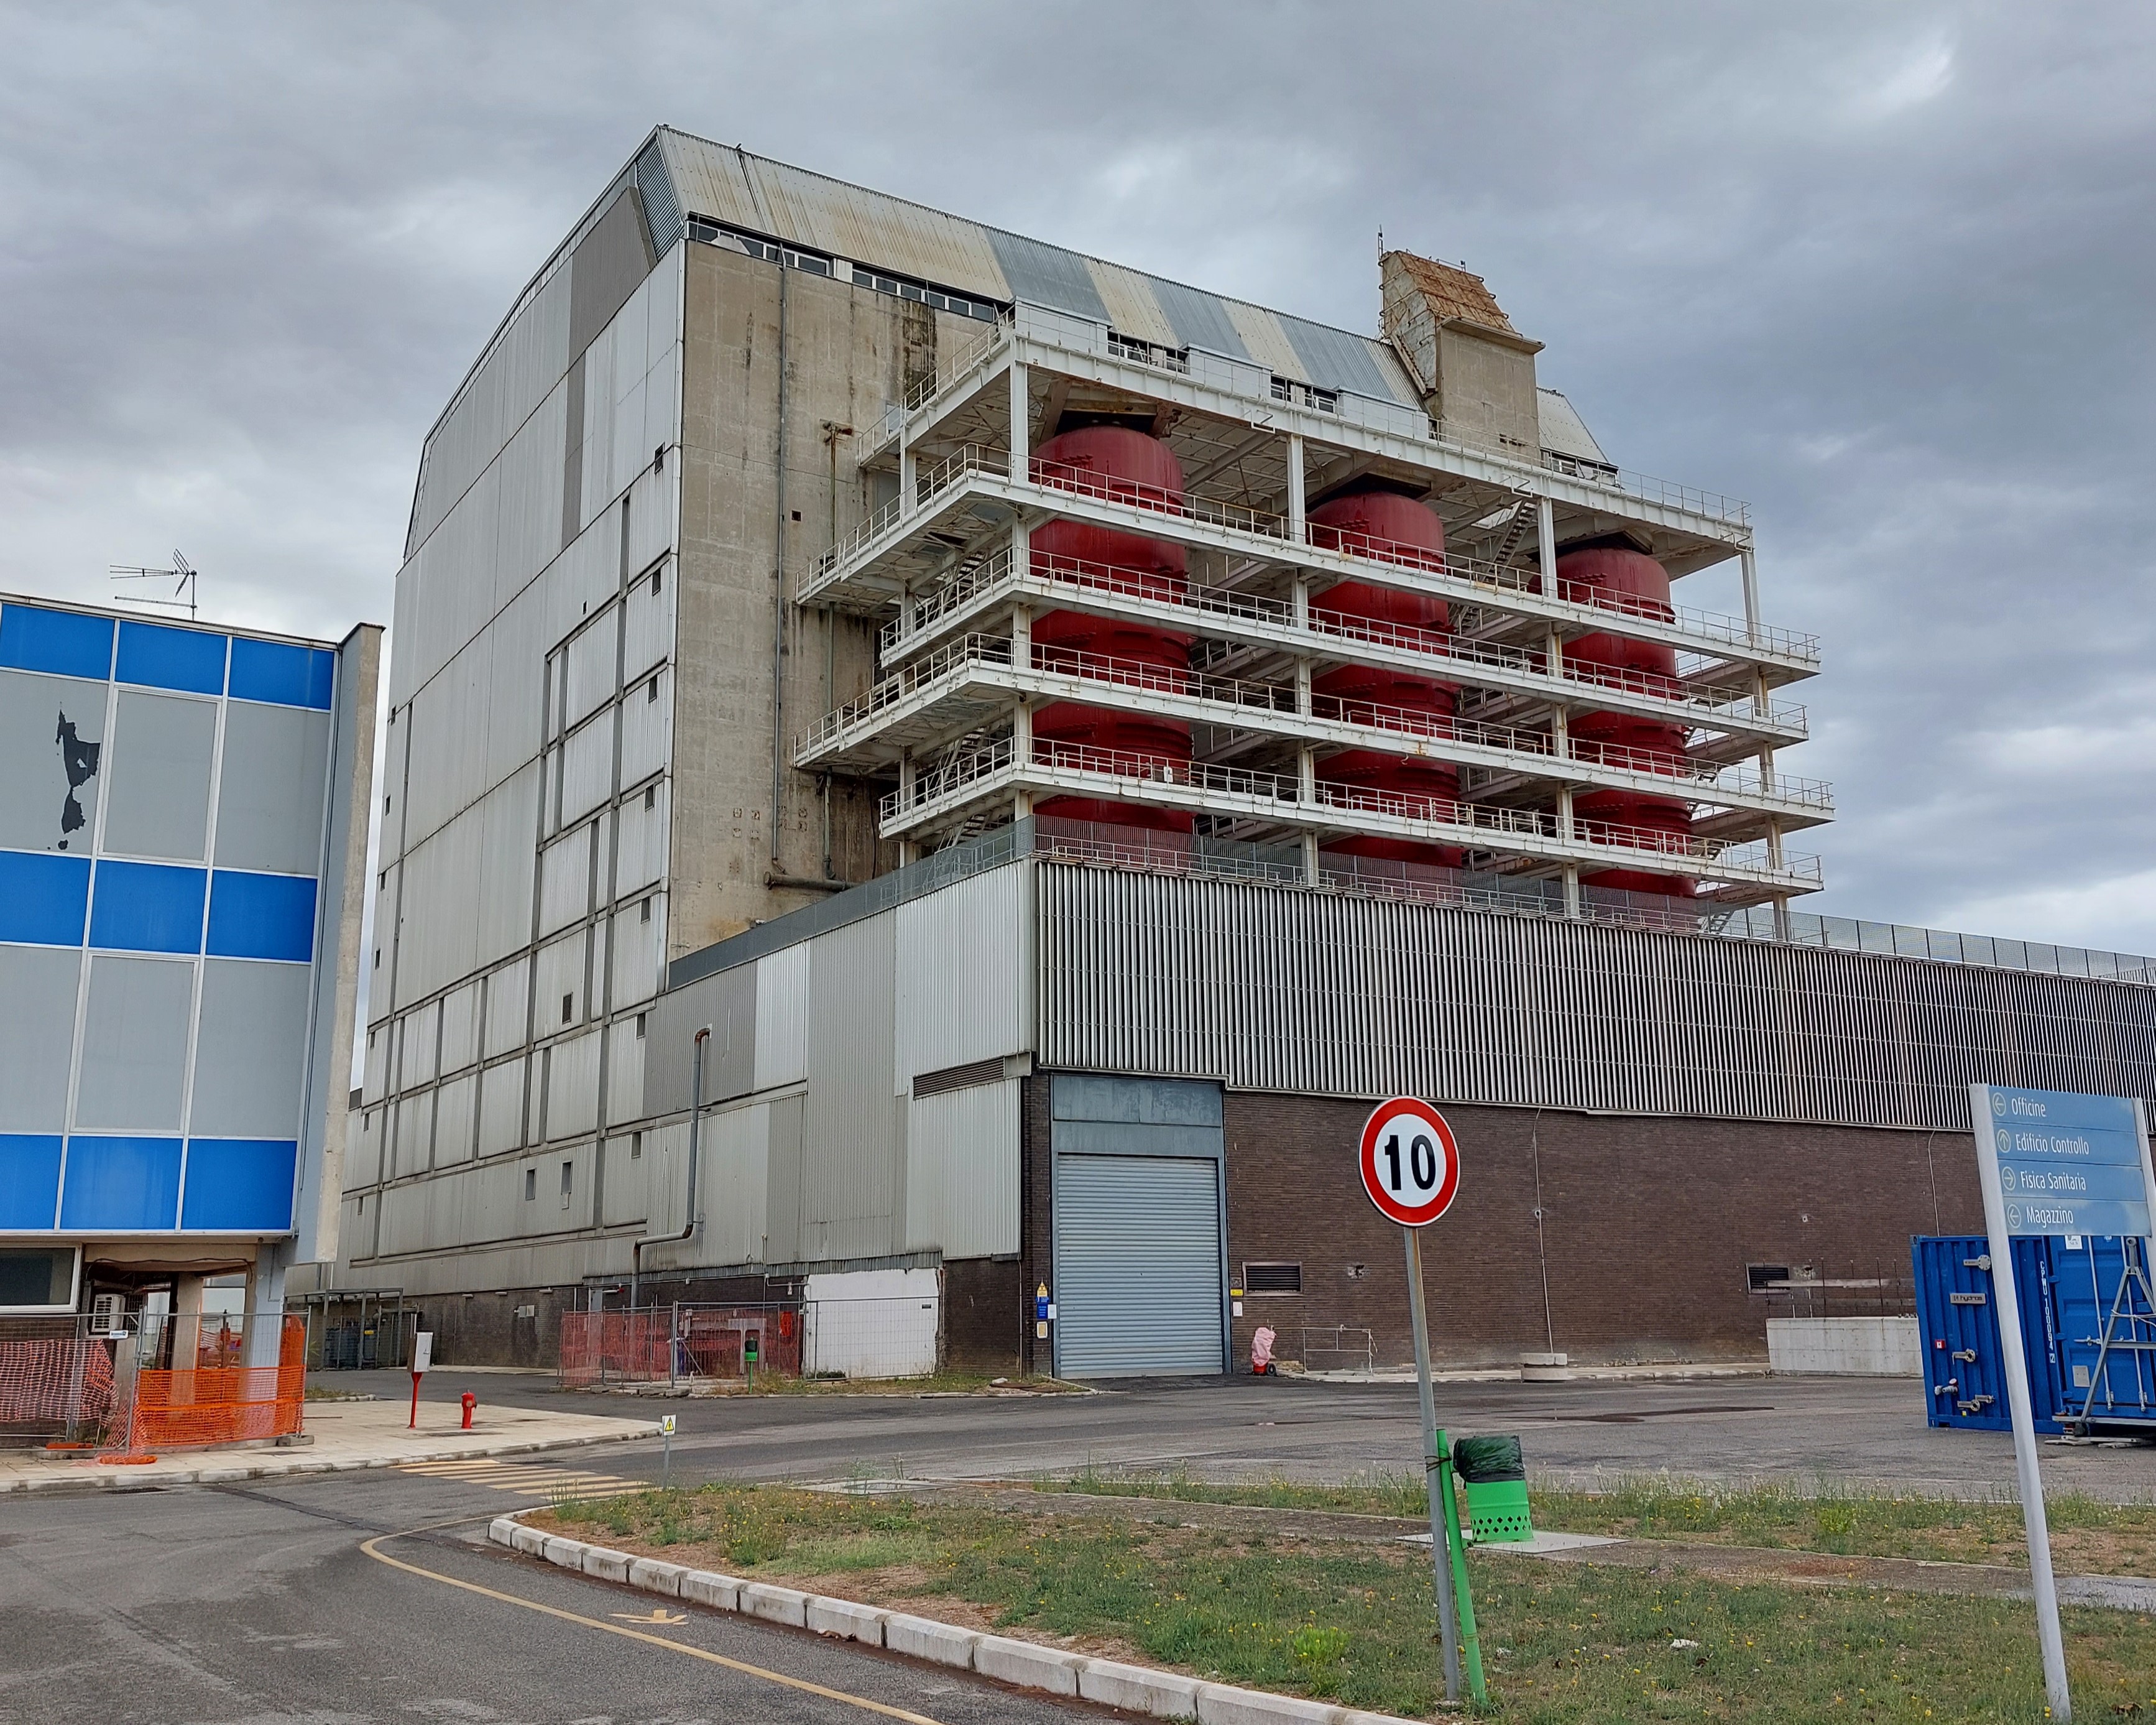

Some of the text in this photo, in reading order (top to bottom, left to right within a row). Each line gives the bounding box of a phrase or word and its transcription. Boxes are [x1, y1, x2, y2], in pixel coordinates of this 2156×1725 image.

[2011, 1098, 2047, 1117] Officine
[2015, 1134, 2089, 1155] Edificio Controllo
[1384, 1135, 1435, 1190] 10
[2020, 1171, 2086, 1191] Fisica Sanitaria
[2026, 1206, 2074, 1228] Magazzino
